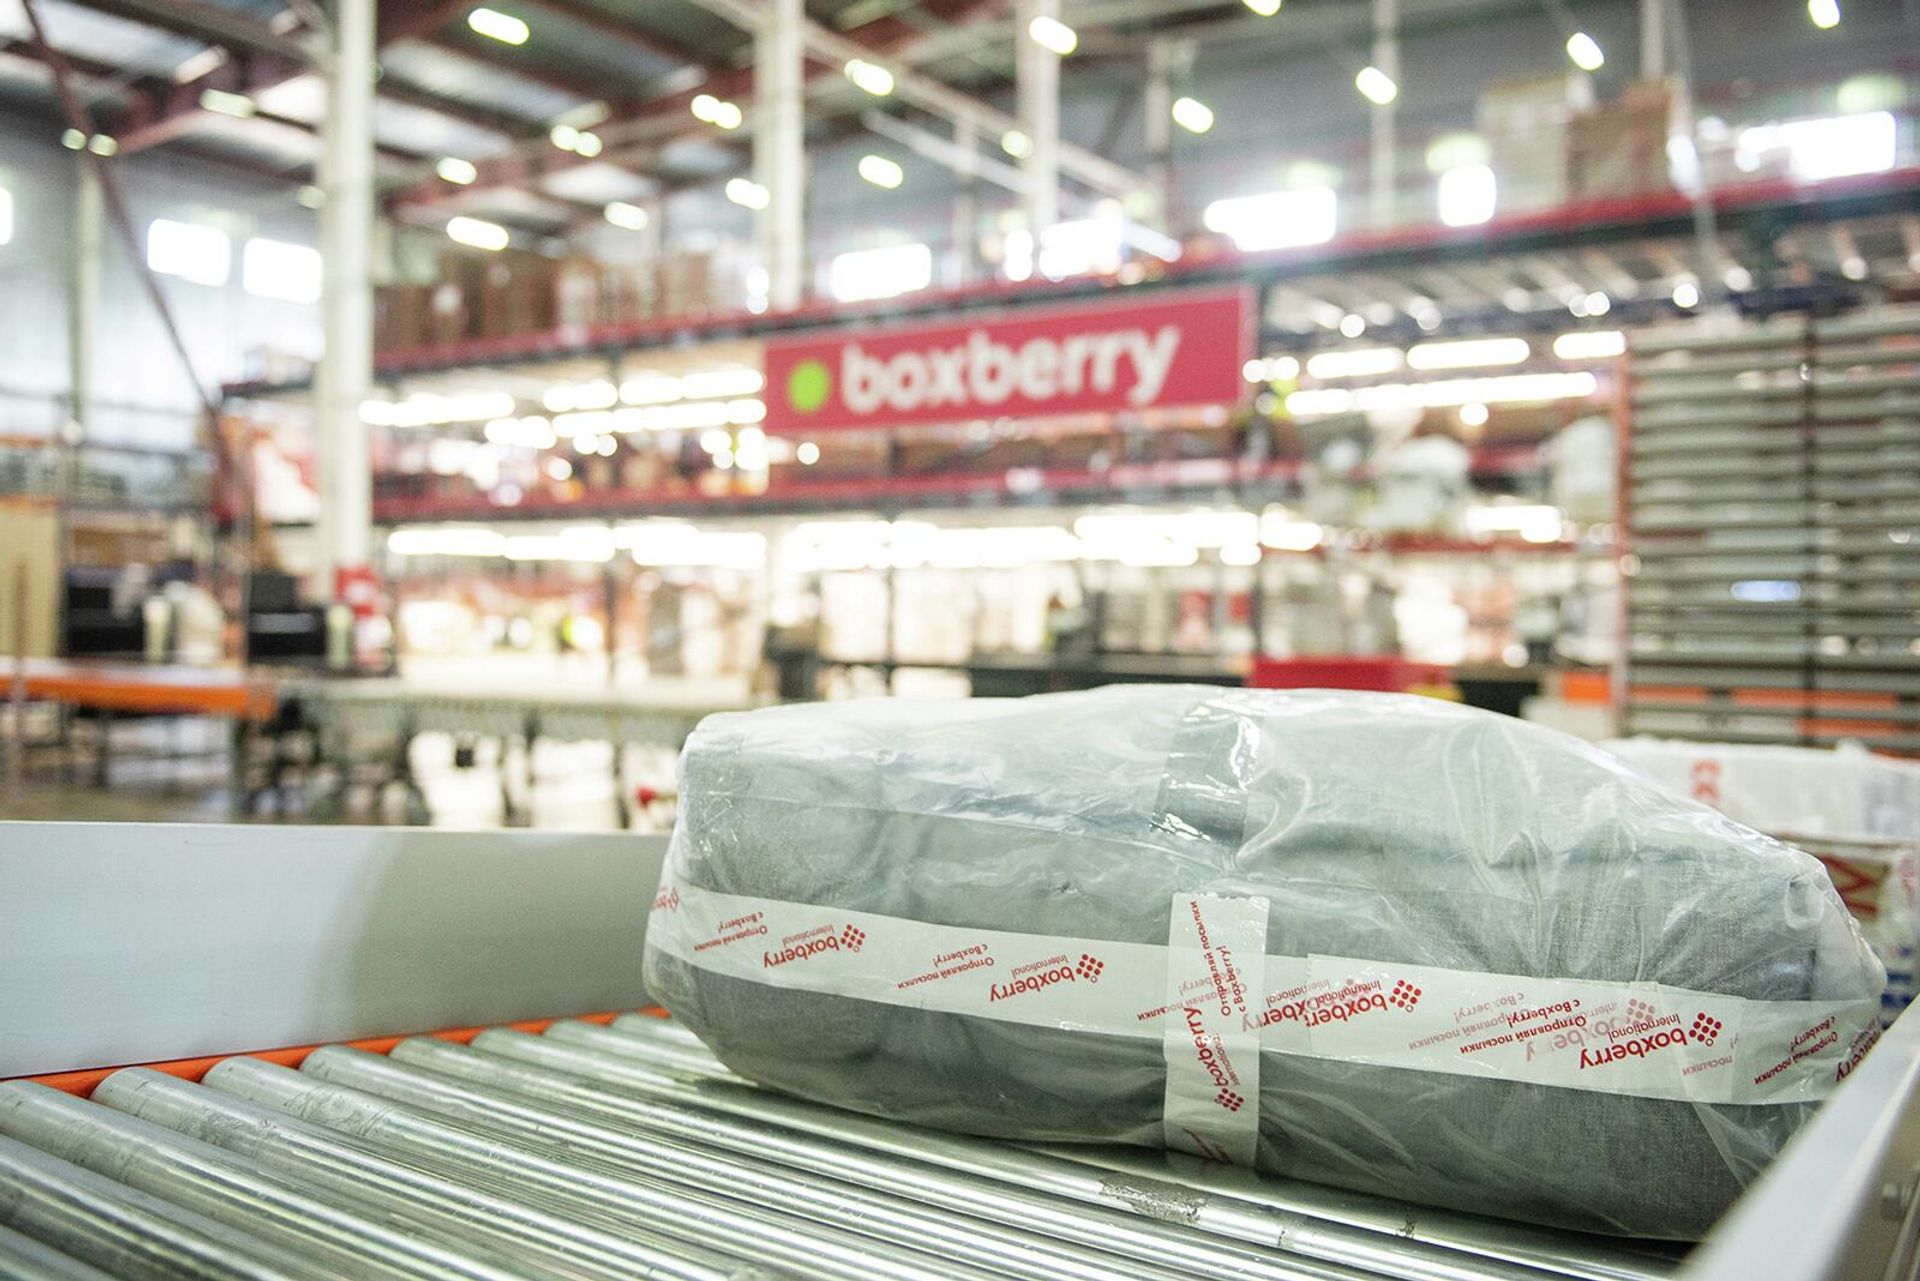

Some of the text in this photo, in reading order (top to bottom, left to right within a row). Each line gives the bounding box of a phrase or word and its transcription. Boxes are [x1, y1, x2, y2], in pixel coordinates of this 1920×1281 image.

[842, 325, 1181, 413] boxberry
[717, 912, 757, 934] Boxberry!
[763, 935, 839, 968] boxberry
[932, 944, 982, 968] Boxberry!
[1011, 953, 1069, 980] International
[1190, 901, 1231, 1016] Отправляй посылки
[897, 956, 995, 990] Отправляй посылки
[989, 965, 1076, 1002] boxberry
[1216, 944, 1244, 1005] Boxberry!
[1508, 1001, 1572, 1028] Boxberry!
[1608, 1013, 1682, 1044] International
[1184, 1007, 1229, 1088] boxberry
[1460, 1015, 1587, 1054] Отправляй посылки
[1579, 1027, 1688, 1070] boxberry
[1682, 1055, 1733, 1076] посылки
[1754, 1057, 1792, 1085] посылки
